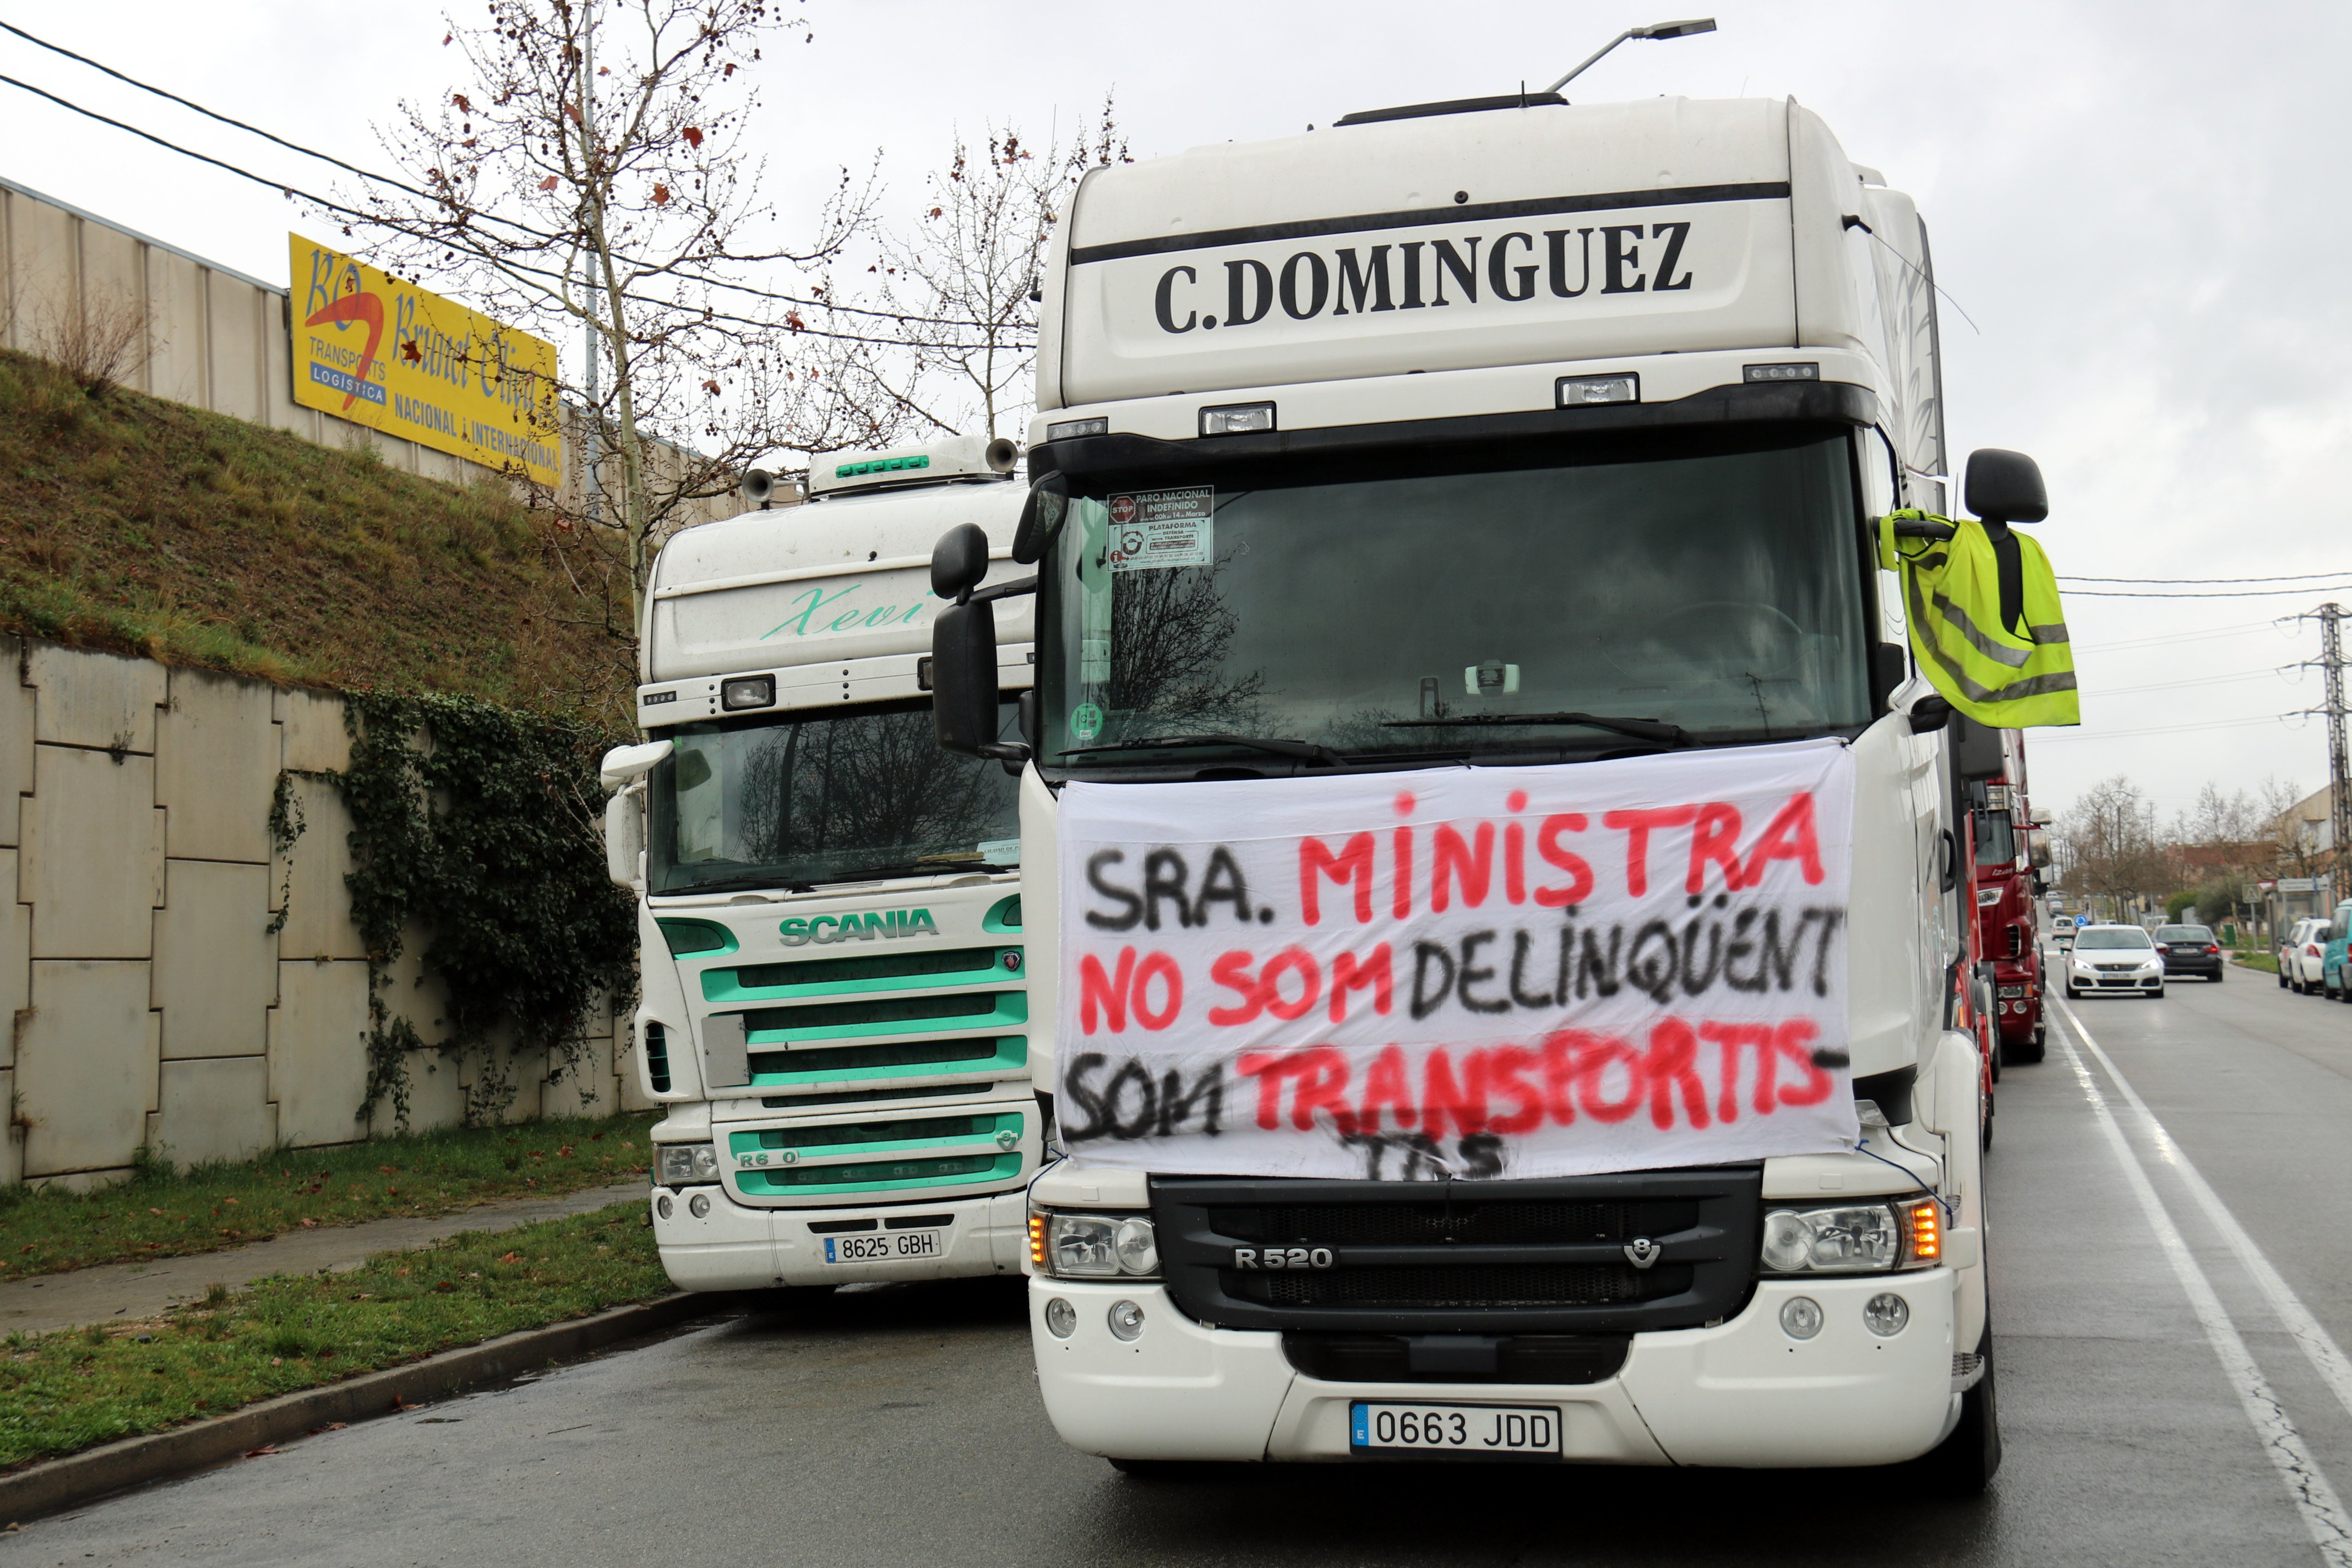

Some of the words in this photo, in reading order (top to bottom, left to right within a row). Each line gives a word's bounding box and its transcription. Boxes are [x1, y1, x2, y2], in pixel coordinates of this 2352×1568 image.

[1155, 221, 1693, 334] C.DOMINGUEZ
[309, 336, 386, 381] TRANSPORTS
[393, 292, 470, 389] Brunet
[313, 367, 383, 402] LOGÍSTICA
[394, 392, 457, 437] NACIONAL
[471, 420, 558, 472] INTERNACIONAL
[1112, 505, 1134, 514] STOP
[1136, 493, 1160, 504] PARO
[1163, 489, 1210, 502] NACIONAL
[1147, 500, 1198, 513] INDEFINIDO
[1148, 522, 1197, 531] PLATAFORMA
[1155, 512, 1166, 520] 00h
[759, 584, 935, 641] Xevi
[1085, 845, 1276, 932] SRA.
[1992, 868, 2013, 876] Izan
[779, 908, 940, 946] SCANIA
[1079, 945, 1184, 1036] NO
[1208, 939, 1395, 1027] SOM
[1061, 1052, 1224, 1143] SOM
[842, 1237, 889, 1259] 8625
[897, 1234, 933, 1255] GBH
[1235, 1248, 1257, 1268] R
[1264, 1247, 1333, 1269] 520
[1357, 1429, 1365, 1440] E
[1376, 1411, 1467, 1445] 0663
[1483, 1414, 1550, 1447] JDD
